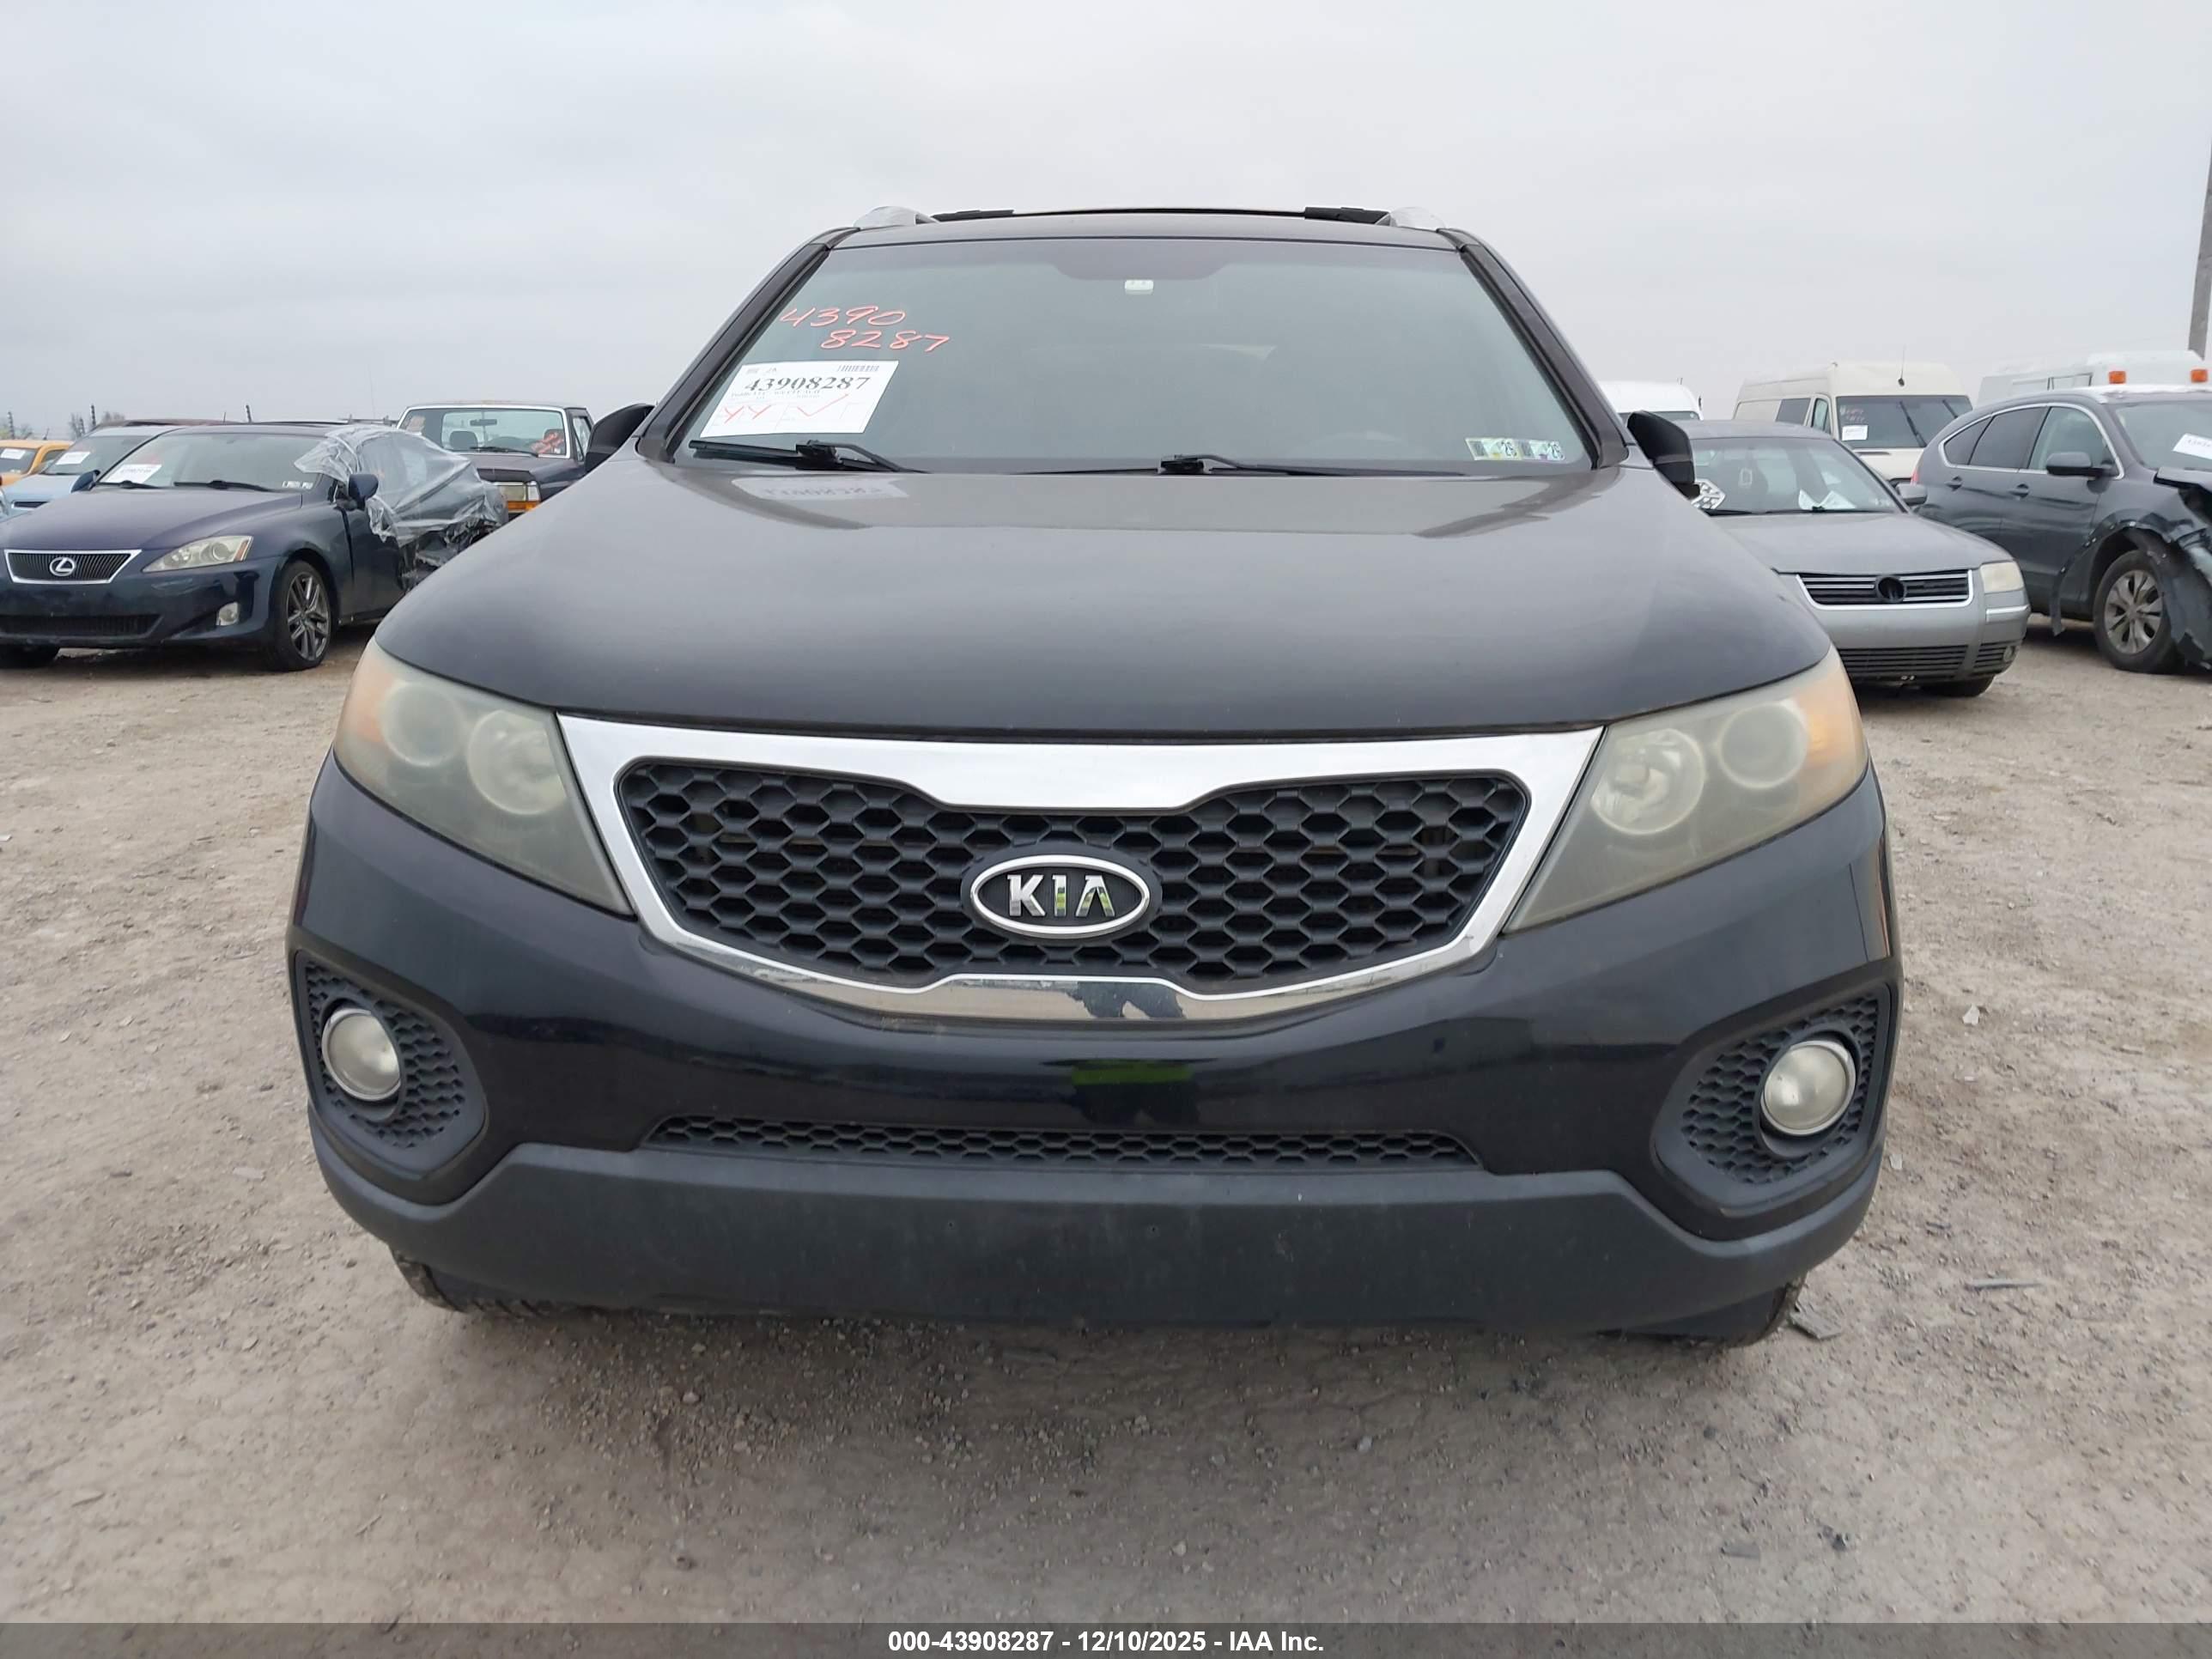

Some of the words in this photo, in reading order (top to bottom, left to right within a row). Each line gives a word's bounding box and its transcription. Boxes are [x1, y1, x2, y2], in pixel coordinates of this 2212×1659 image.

[779, 305, 906, 327] 4390
[819, 329, 951, 353] 8287
[744, 376, 871, 392] 43908287
[1007, 874, 1115, 917] KIA
